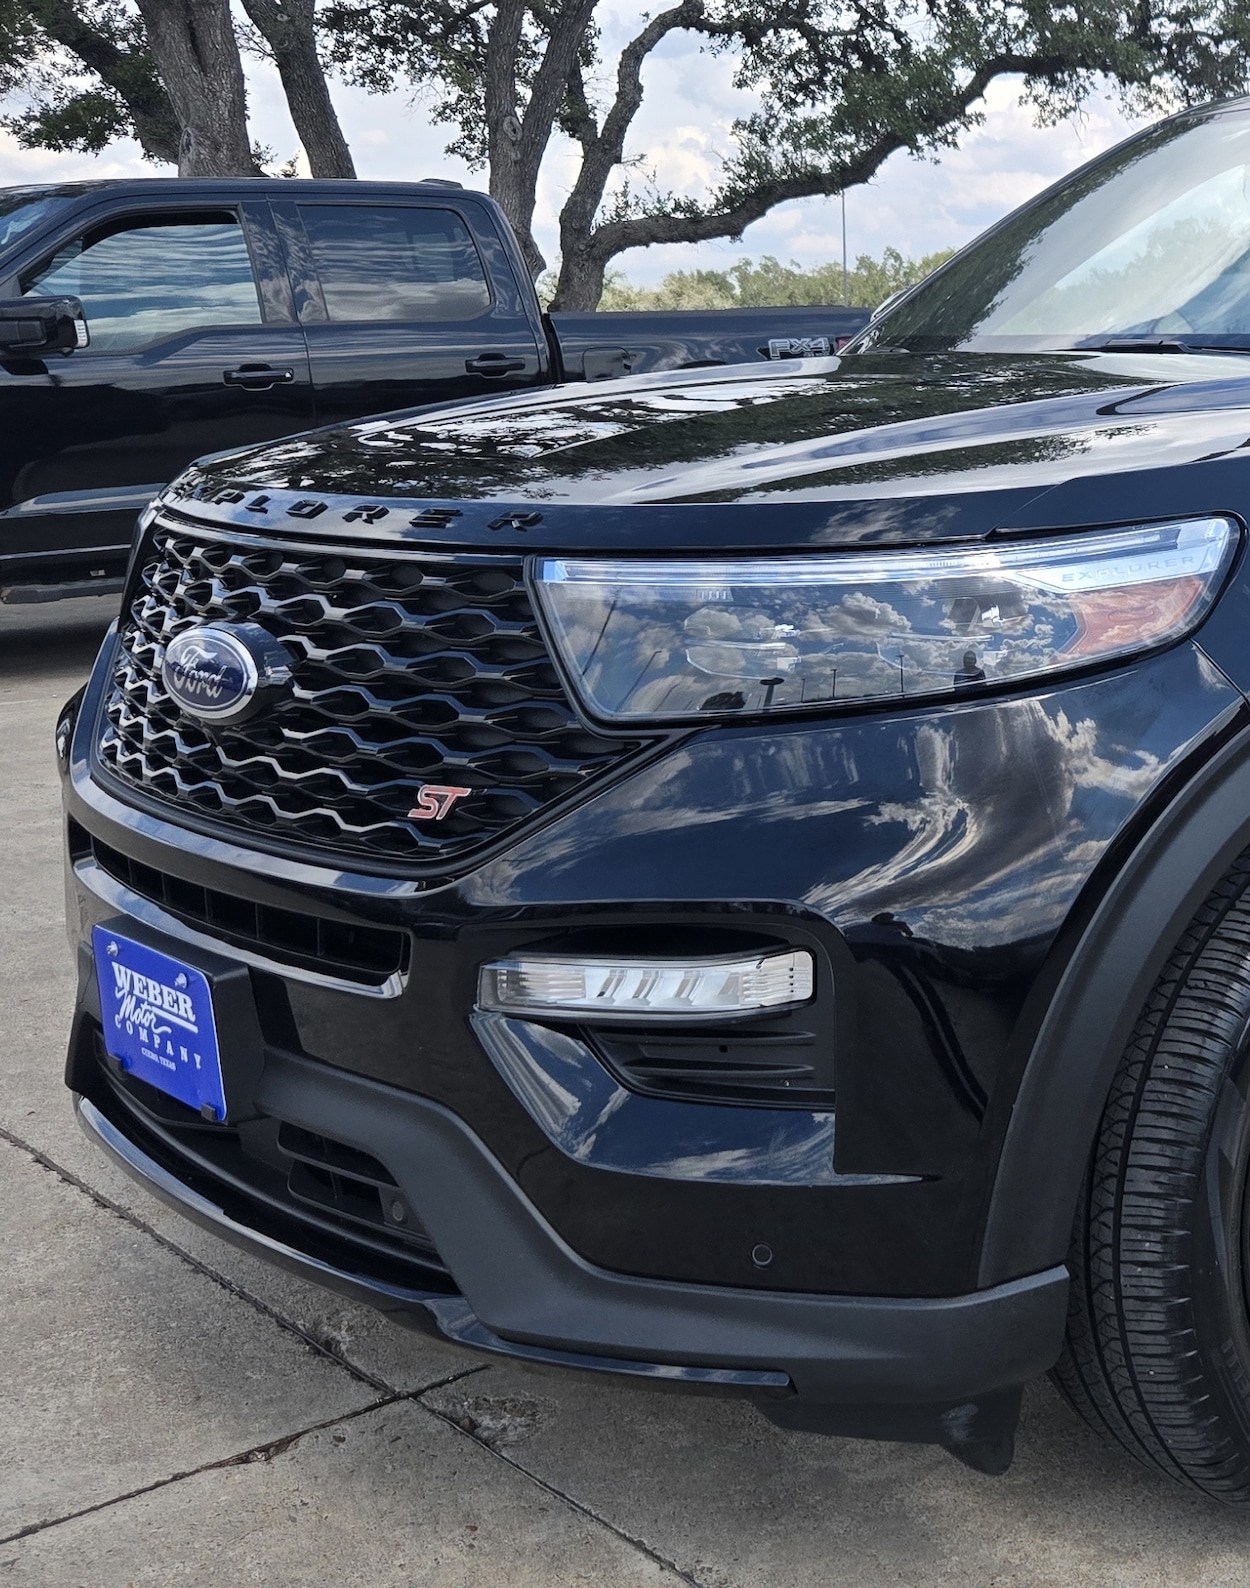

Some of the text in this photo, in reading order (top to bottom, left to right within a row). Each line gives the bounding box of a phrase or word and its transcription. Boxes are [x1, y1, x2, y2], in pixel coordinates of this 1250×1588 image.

[767, 337, 830, 360] FX4
[190, 485, 545, 532] PLORER
[1061, 555, 1195, 583] EXPLORER
[174, 645, 230, 699] Ford
[408, 784, 471, 820] ST
[112, 961, 196, 1022] WEBER
[115, 986, 172, 1034] Motor
[115, 1014, 202, 1069] COMPANY
